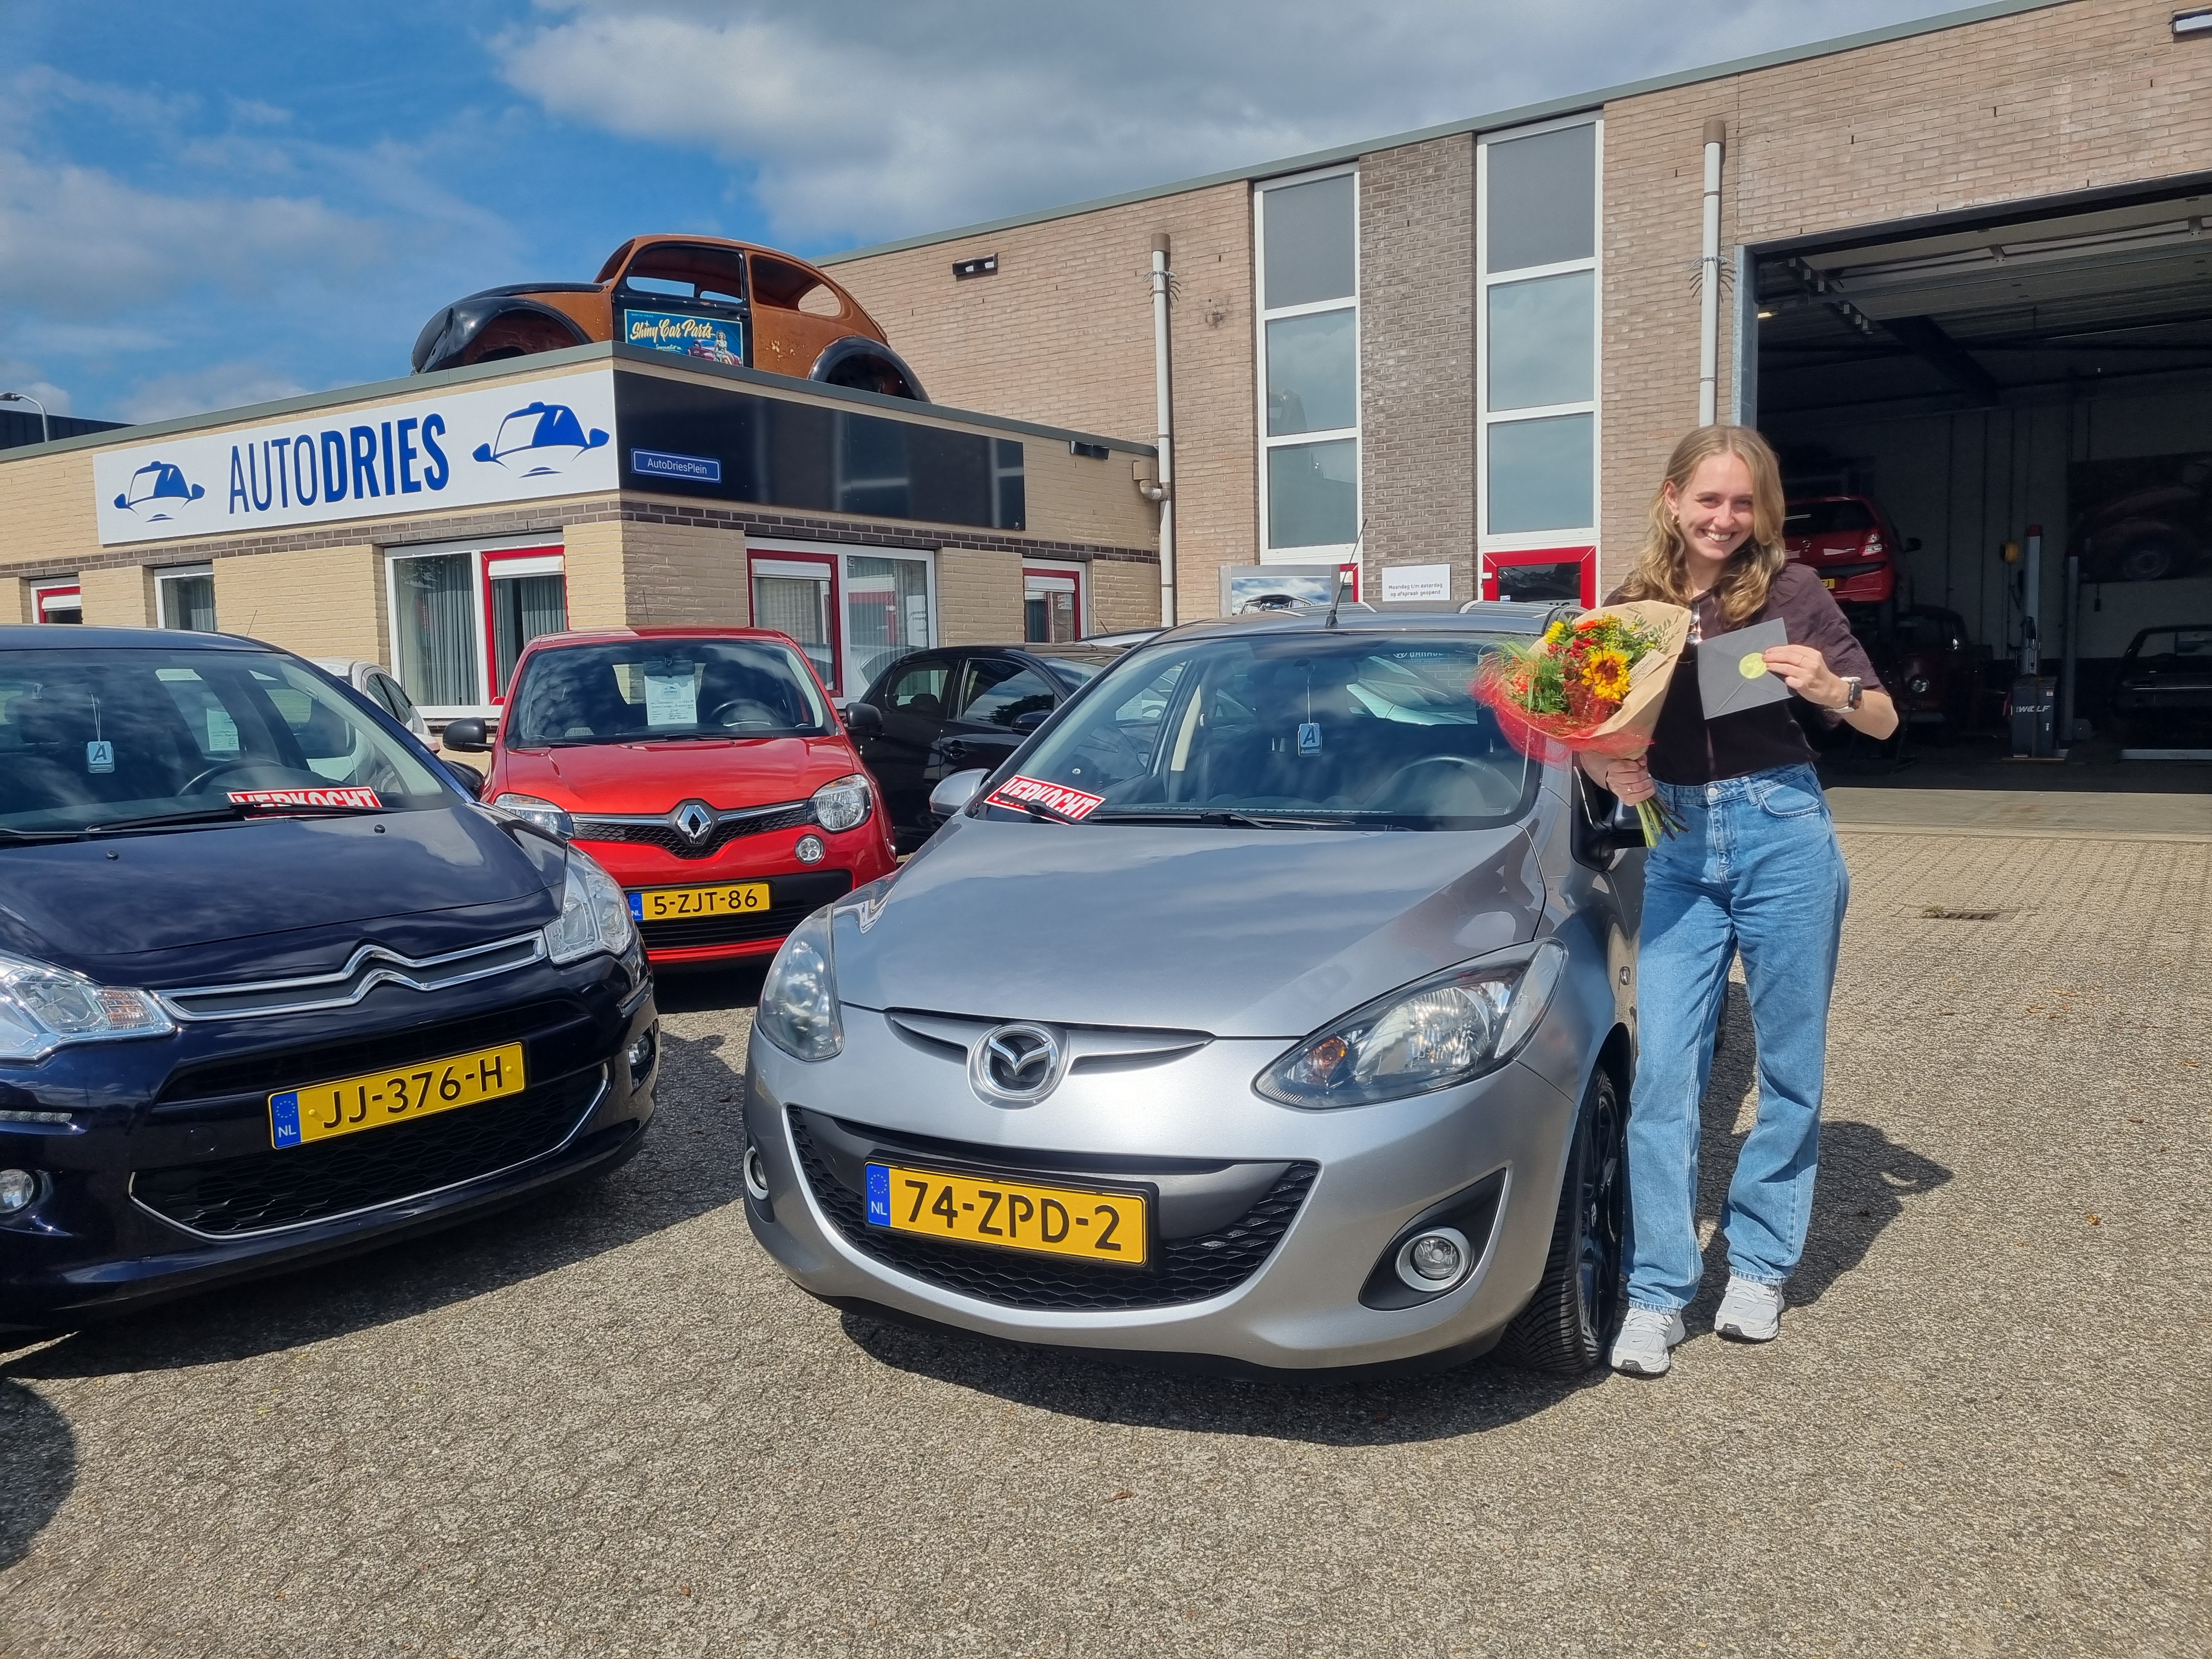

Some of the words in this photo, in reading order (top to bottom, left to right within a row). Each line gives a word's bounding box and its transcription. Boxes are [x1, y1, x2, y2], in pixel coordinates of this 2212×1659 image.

[630, 320, 658, 343] Shiny
[659, 319, 681, 342] Car
[682, 319, 715, 338] Parts
[229, 413, 449, 515] AUTODRIES
[647, 458, 707, 474] AutoDriesPlein
[654, 889, 758, 915] 5-ZJT-86
[278, 1124, 297, 1138] NL
[323, 1054, 503, 1128] JJ-376-H
[870, 1201, 888, 1216] NL
[905, 1179, 1121, 1251] 74-ZPD-2
